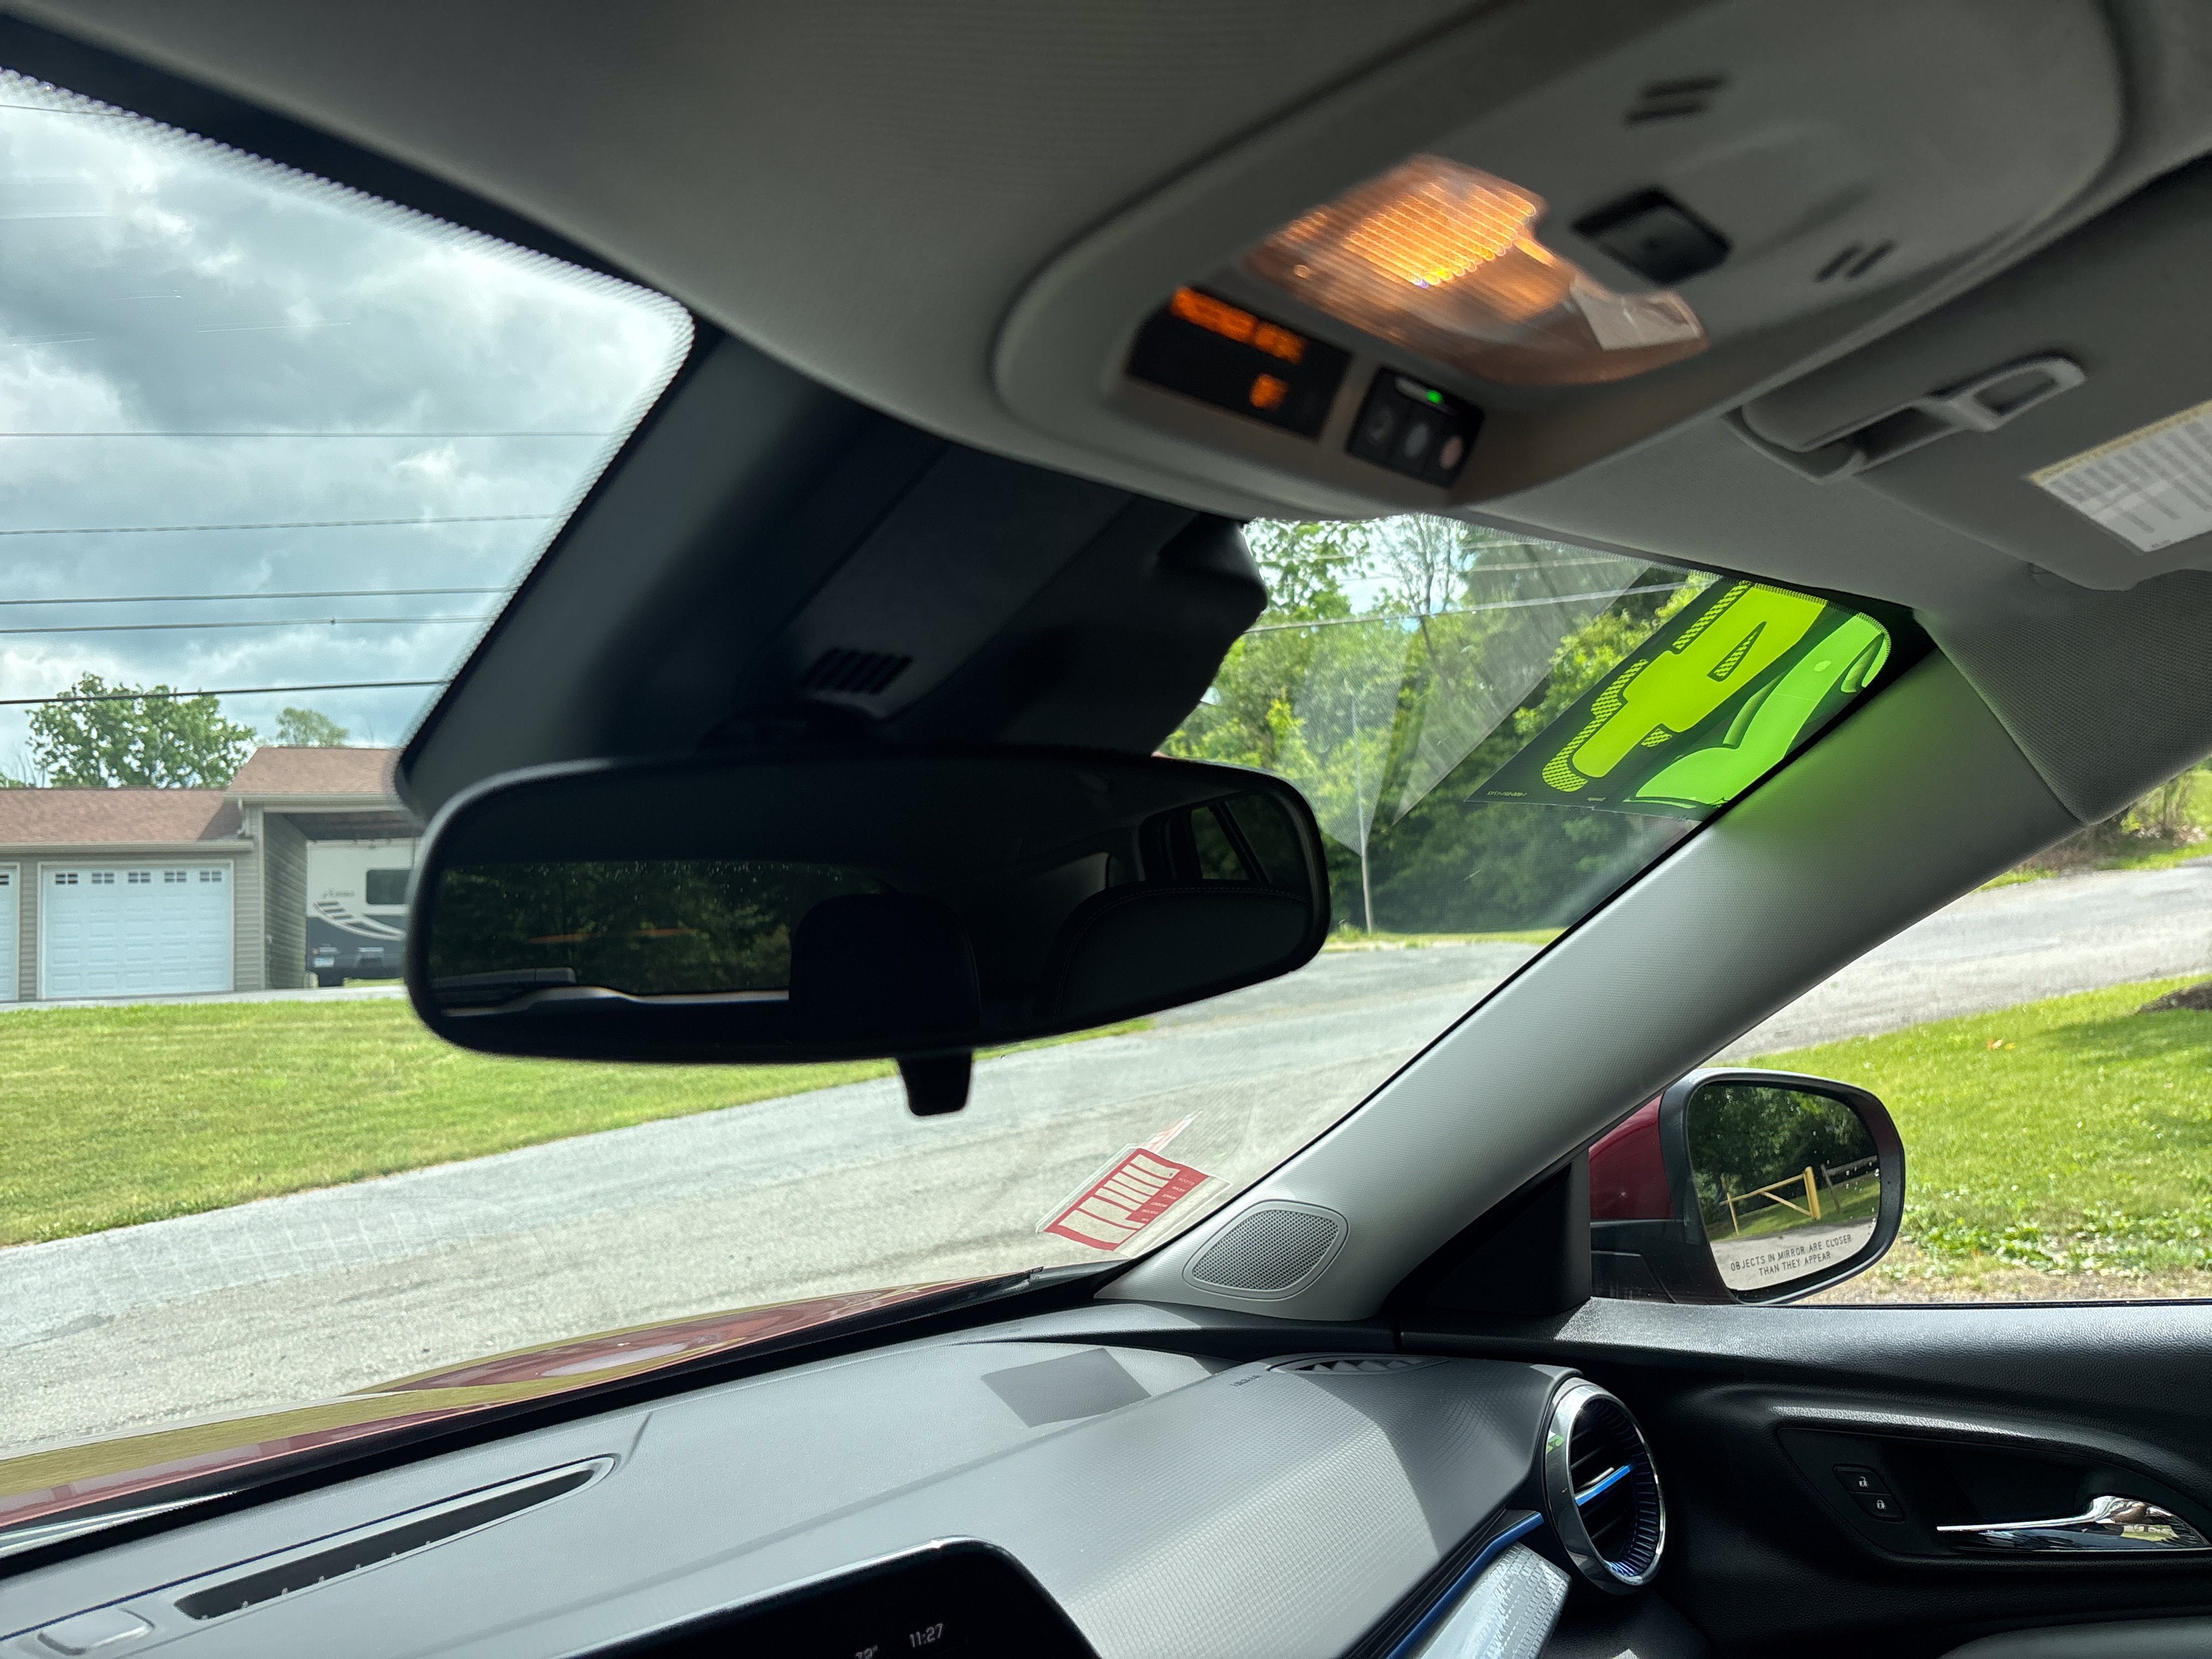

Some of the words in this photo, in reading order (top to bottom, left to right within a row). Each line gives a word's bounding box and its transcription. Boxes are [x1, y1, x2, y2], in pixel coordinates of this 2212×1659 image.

[1730, 1255, 1765, 1272] OBJECTS
[1767, 1254, 1775, 1262] IN
[1778, 1246, 1805, 1261] MIRROR
[1808, 1241, 1822, 1252] ARE
[1825, 1234, 1852, 1248] CLOSER
[1758, 1266, 1780, 1277] THAN
[1782, 1259, 1800, 1271] THEY
[1804, 1251, 1831, 1265] APPEAR
[909, 1623, 943, 1648] 11:27
